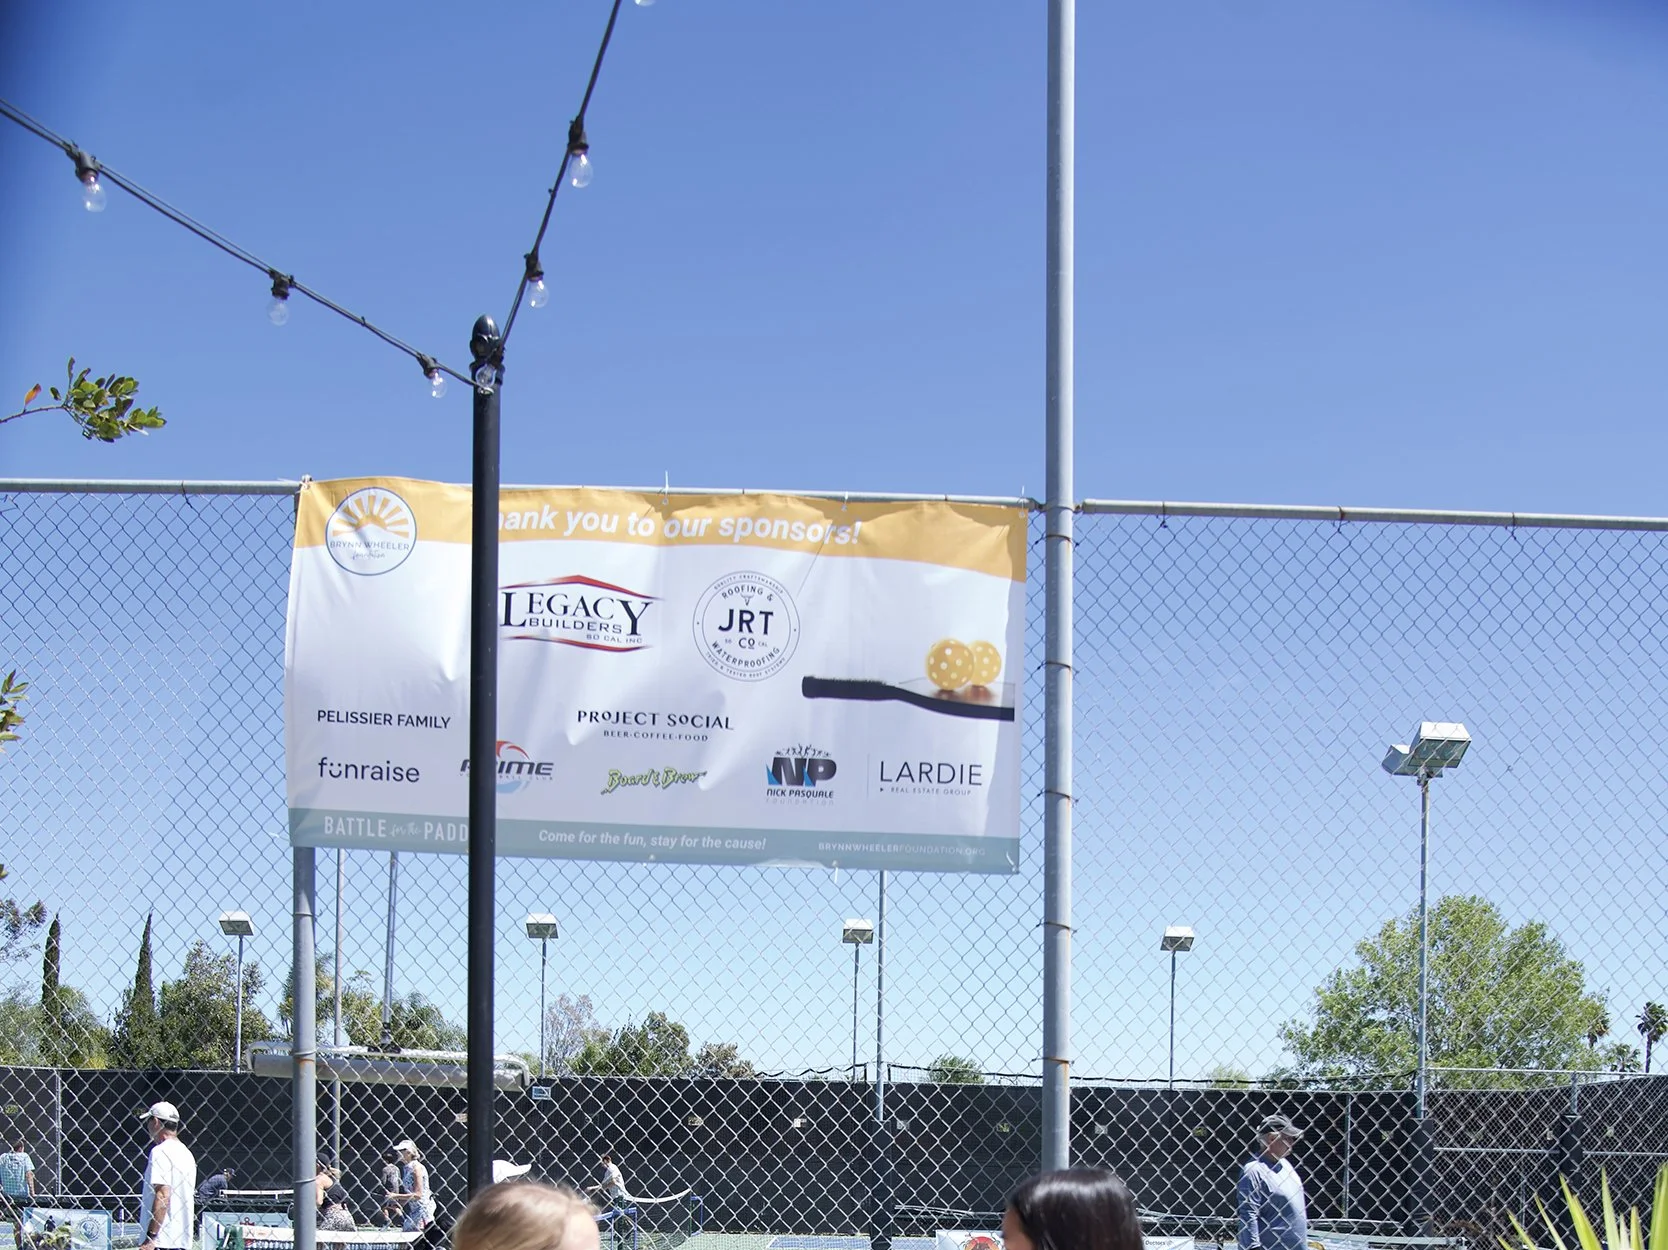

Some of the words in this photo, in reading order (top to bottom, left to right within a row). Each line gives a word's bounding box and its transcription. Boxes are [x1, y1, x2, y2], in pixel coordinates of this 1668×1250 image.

[499, 504, 558, 530] ank
[564, 511, 619, 536] you
[627, 511, 655, 537] to
[663, 517, 713, 539] our
[718, 516, 862, 545] sponsors!
[330, 541, 361, 549] BRYNN
[364, 541, 410, 551] WHEELER
[721, 584, 764, 600] ROOFING
[499, 591, 654, 637] LEGACY
[718, 608, 774, 635] JRT
[529, 617, 622, 634] BUILDERS
[712, 640, 780, 668] WATERPROOFING
[317, 709, 393, 726] PELISSIER
[397, 713, 451, 729] FAMILY
[577, 710, 660, 726] PROJECT
[667, 713, 734, 731] SOCIAL
[880, 761, 983, 786] LARDIE
[766, 788, 786, 797] NICK
[788, 789, 834, 799] PASQUALE
[324, 815, 387, 838] BATTLE
[424, 821, 469, 842] PADD
[538, 829, 576, 843] Come
[578, 831, 597, 844] for
[600, 831, 621, 845] the
[623, 833, 647, 847] fun,
[650, 834, 677, 850] stay
[680, 835, 699, 848] for
[701, 836, 721, 849] the
[725, 837, 767, 850] cause!
